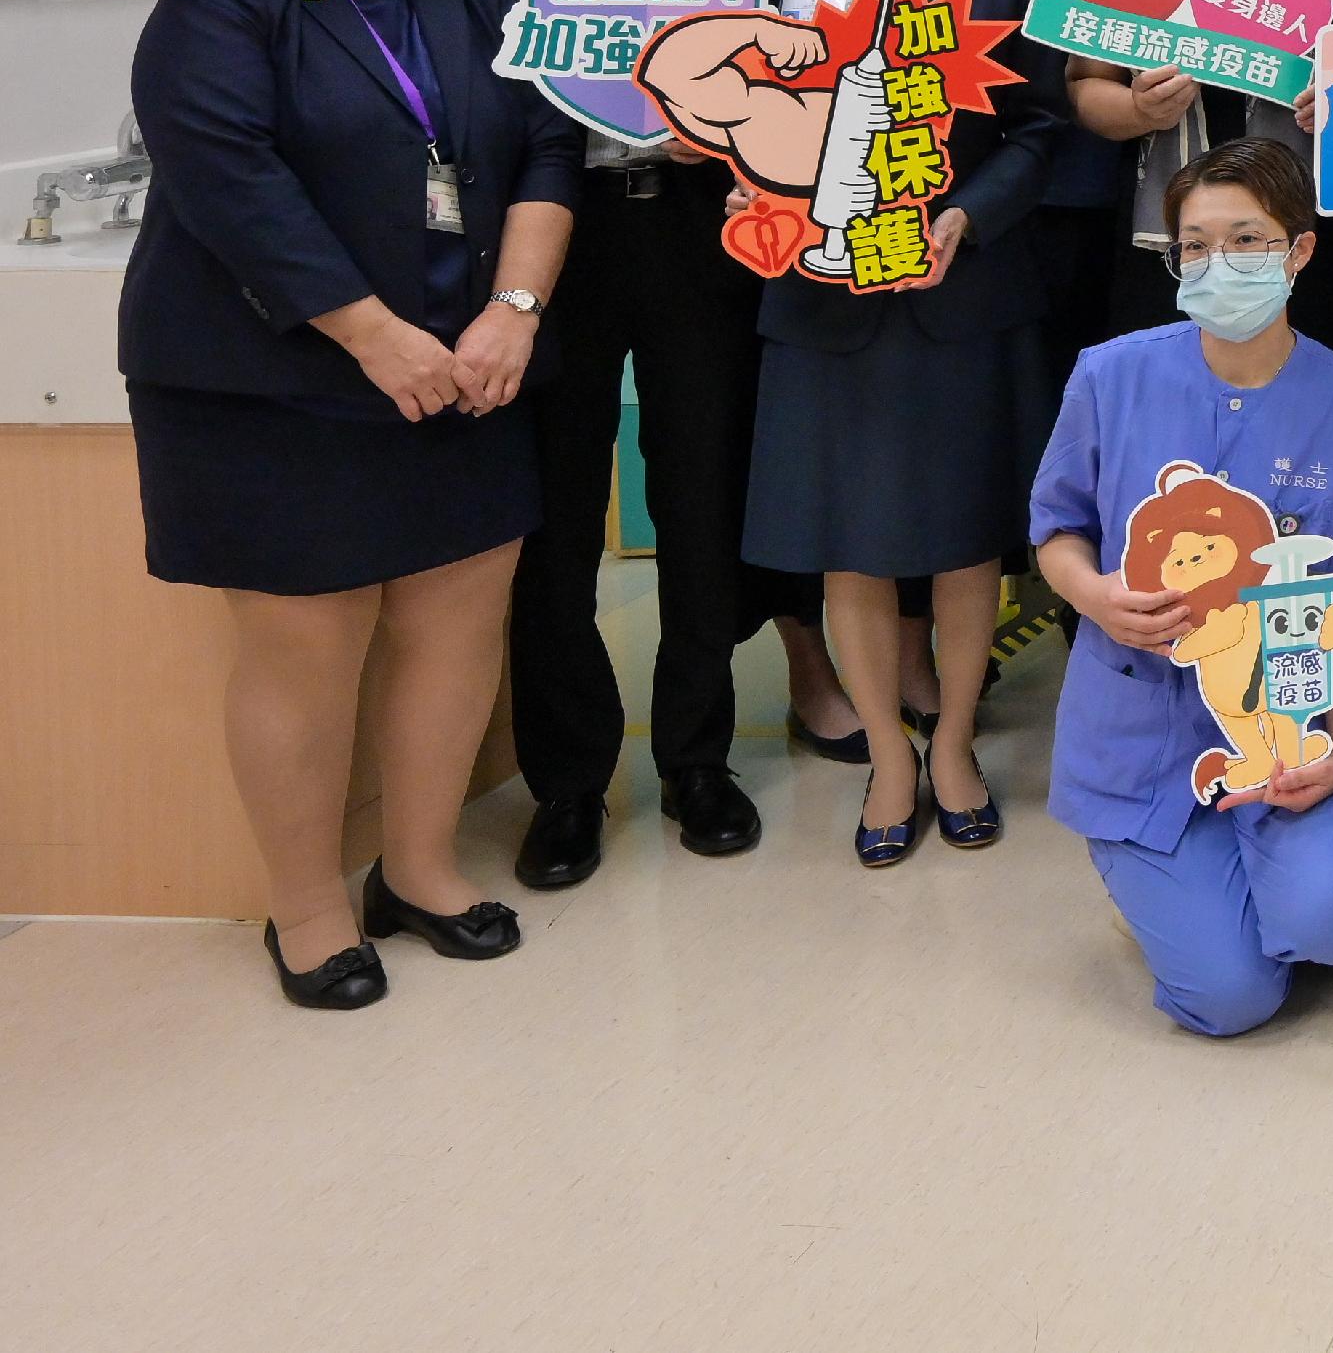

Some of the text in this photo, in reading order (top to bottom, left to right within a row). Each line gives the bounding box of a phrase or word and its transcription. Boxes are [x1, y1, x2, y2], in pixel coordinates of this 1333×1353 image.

[511, 9, 661, 72] 加強
[1059, 6, 1283, 88] 接種流感疫苗
[846, 3, 957, 287] 加強保護
[1273, 457, 1329, 475] 護士
[1269, 473, 1328, 490] NURSE
[1274, 652, 1323, 679] 流感
[1276, 679, 1323, 707] 疫苗
